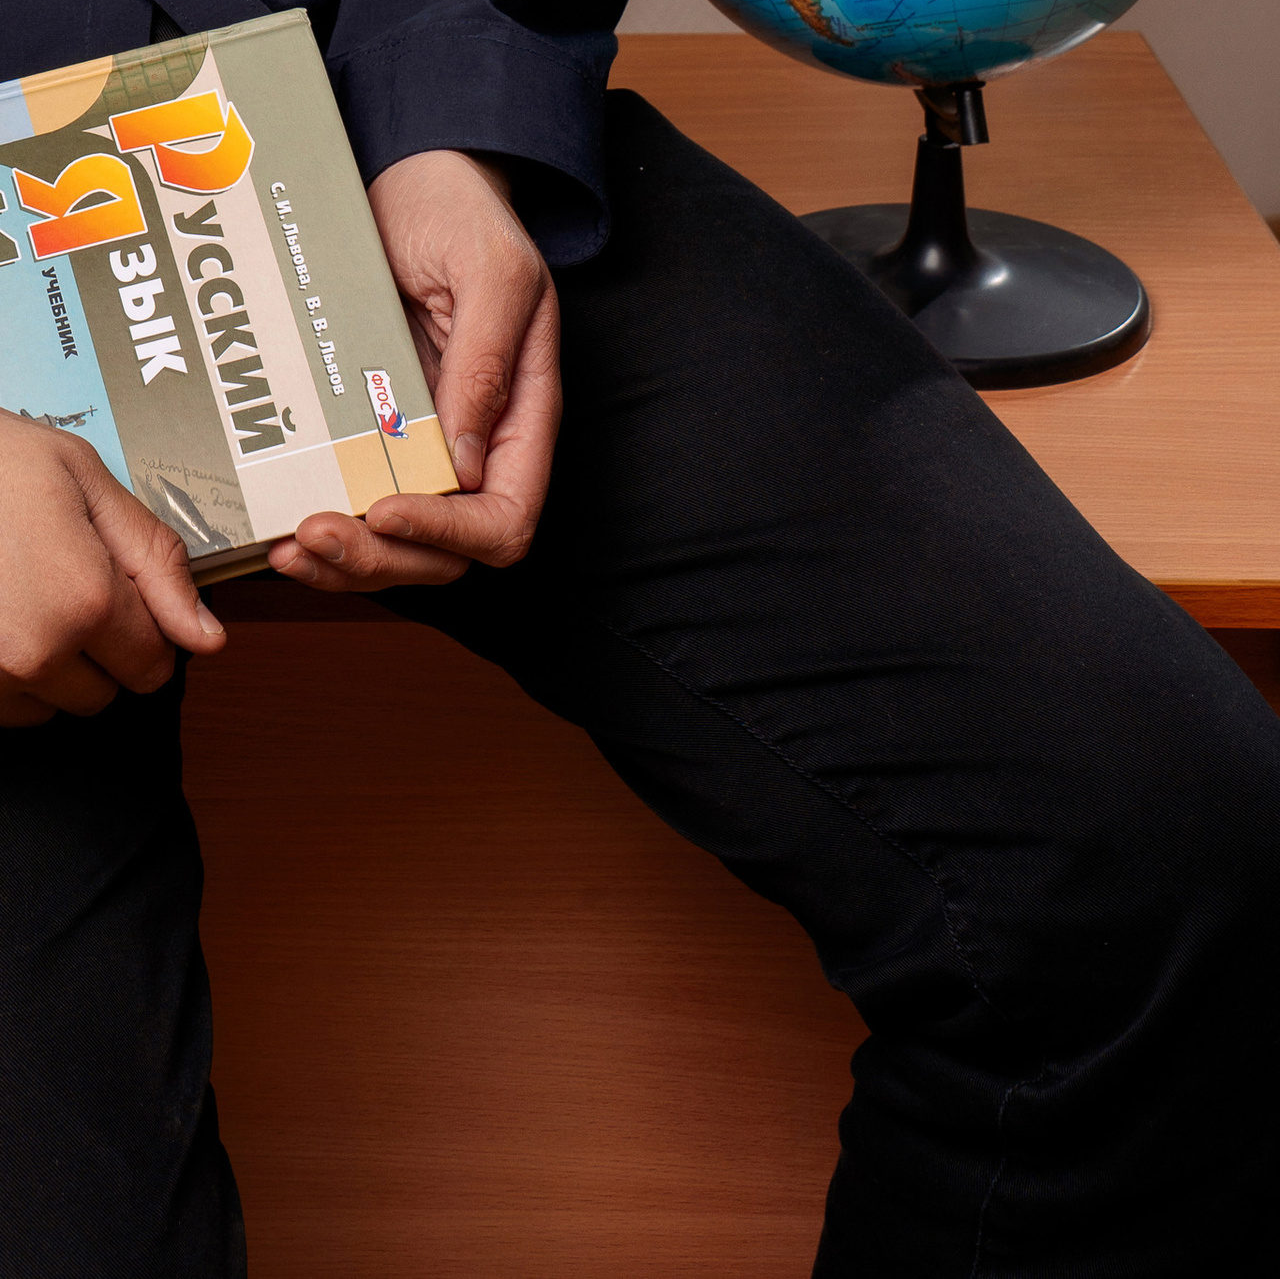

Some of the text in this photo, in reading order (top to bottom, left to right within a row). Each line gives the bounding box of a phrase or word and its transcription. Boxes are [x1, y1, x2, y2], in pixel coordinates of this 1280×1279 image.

[41, 265, 79, 360] УЧЕБНИК
[270, 181, 345, 397] С. И. Львова, В. В. Львов
[370, 372, 392, 411] ФГОС
